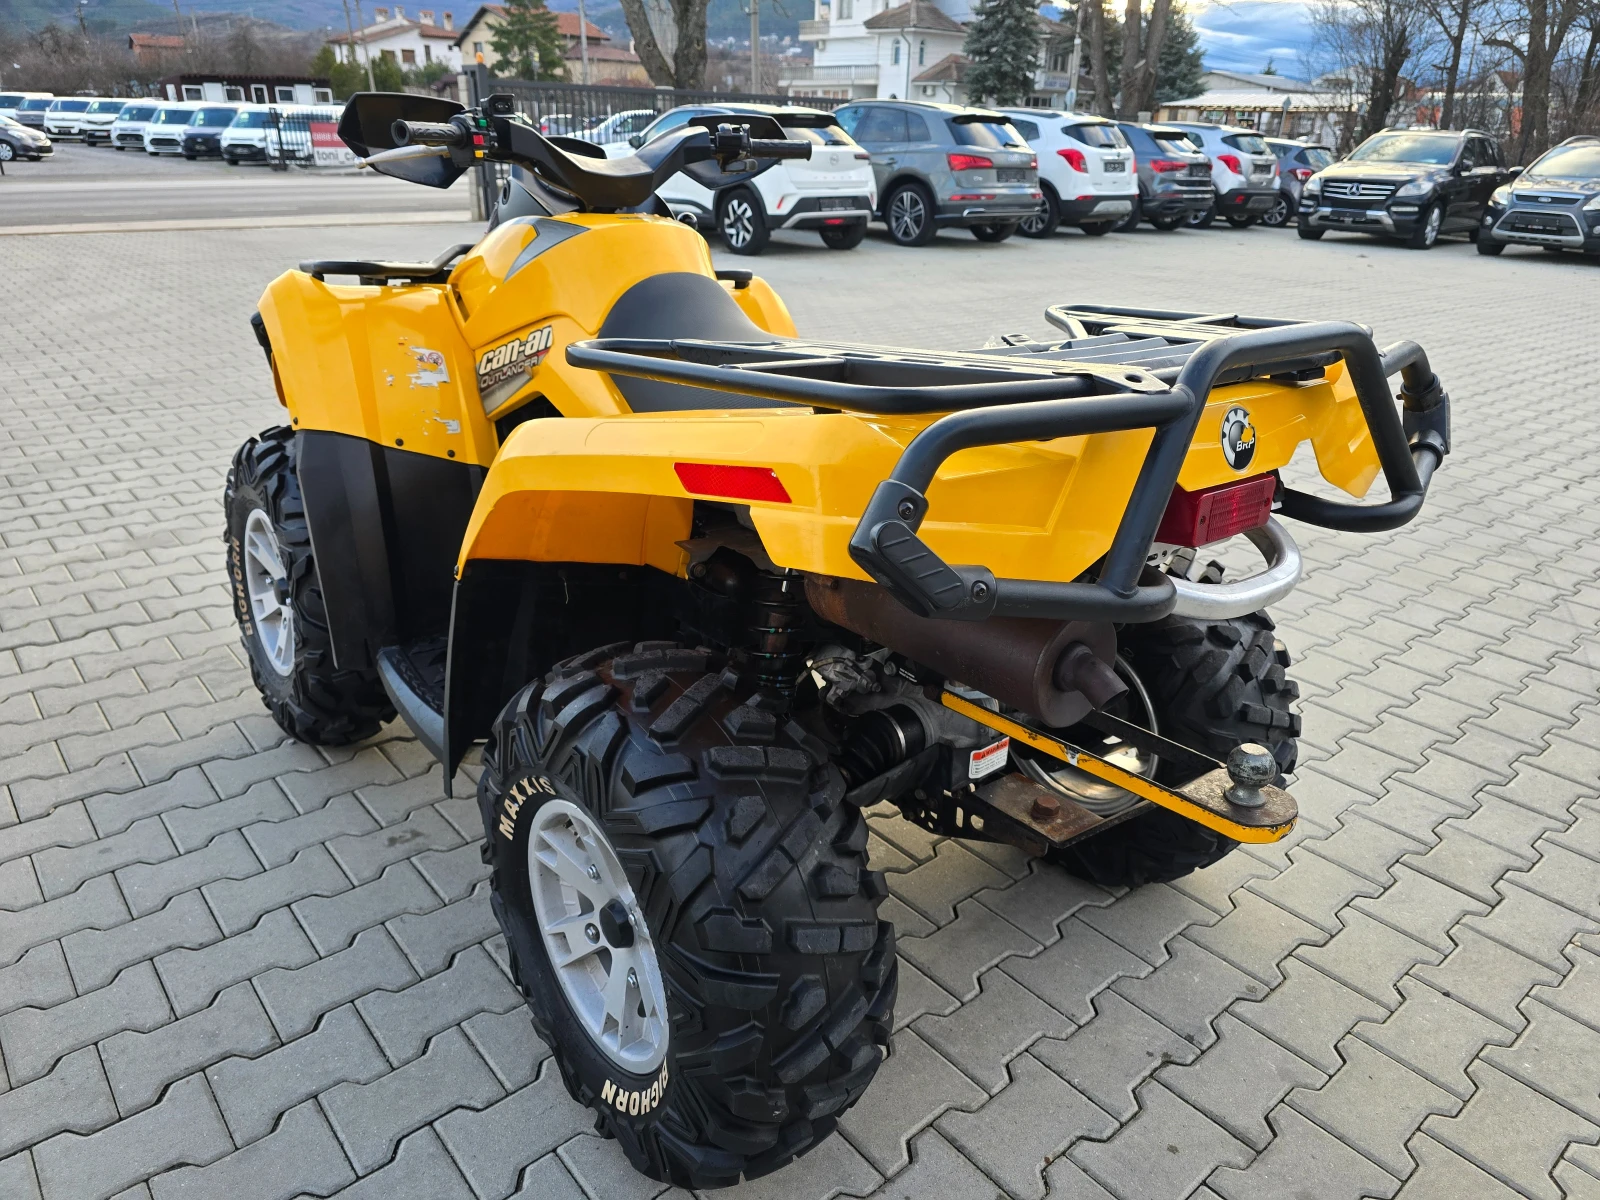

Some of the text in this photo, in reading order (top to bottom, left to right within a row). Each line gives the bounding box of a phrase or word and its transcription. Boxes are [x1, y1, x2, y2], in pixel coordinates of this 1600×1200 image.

[480, 355, 538, 388] OUTLANDER
[1236, 437, 1254, 451] BRP
[231, 536, 253, 636] BIGHORN
[499, 776, 556, 841] MAXXIS
[600, 1056, 668, 1116] BIGHORN
